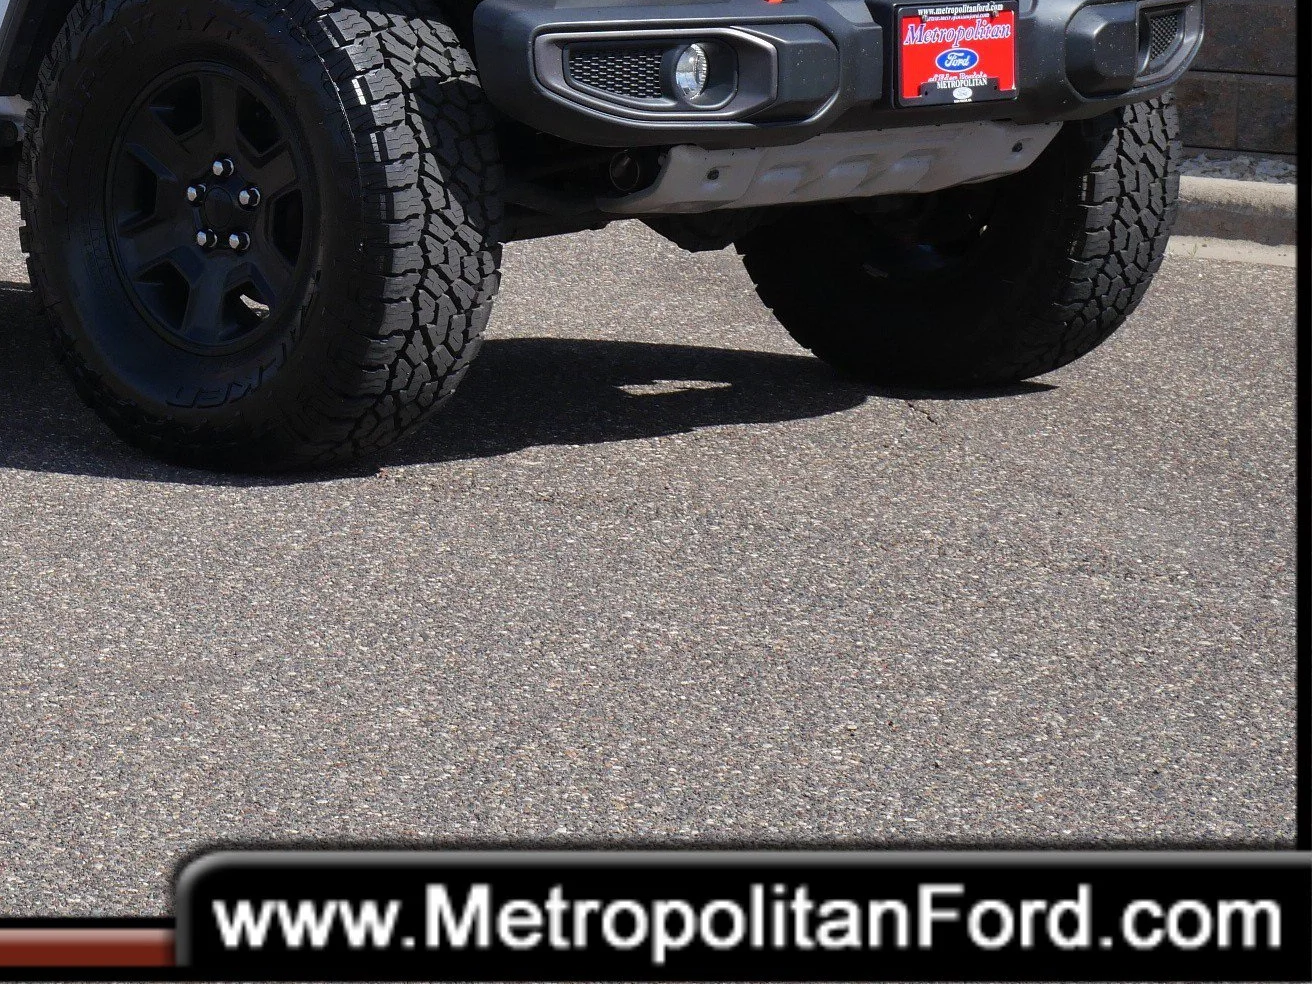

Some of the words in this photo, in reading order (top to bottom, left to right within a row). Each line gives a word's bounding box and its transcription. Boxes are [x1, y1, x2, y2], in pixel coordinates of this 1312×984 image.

[918, 2, 1003, 16] www.metropolitanford.com
[903, 19, 1010, 48] Metropolitan
[944, 52, 970, 67] Ford
[936, 77, 988, 89] METROPOLITAN
